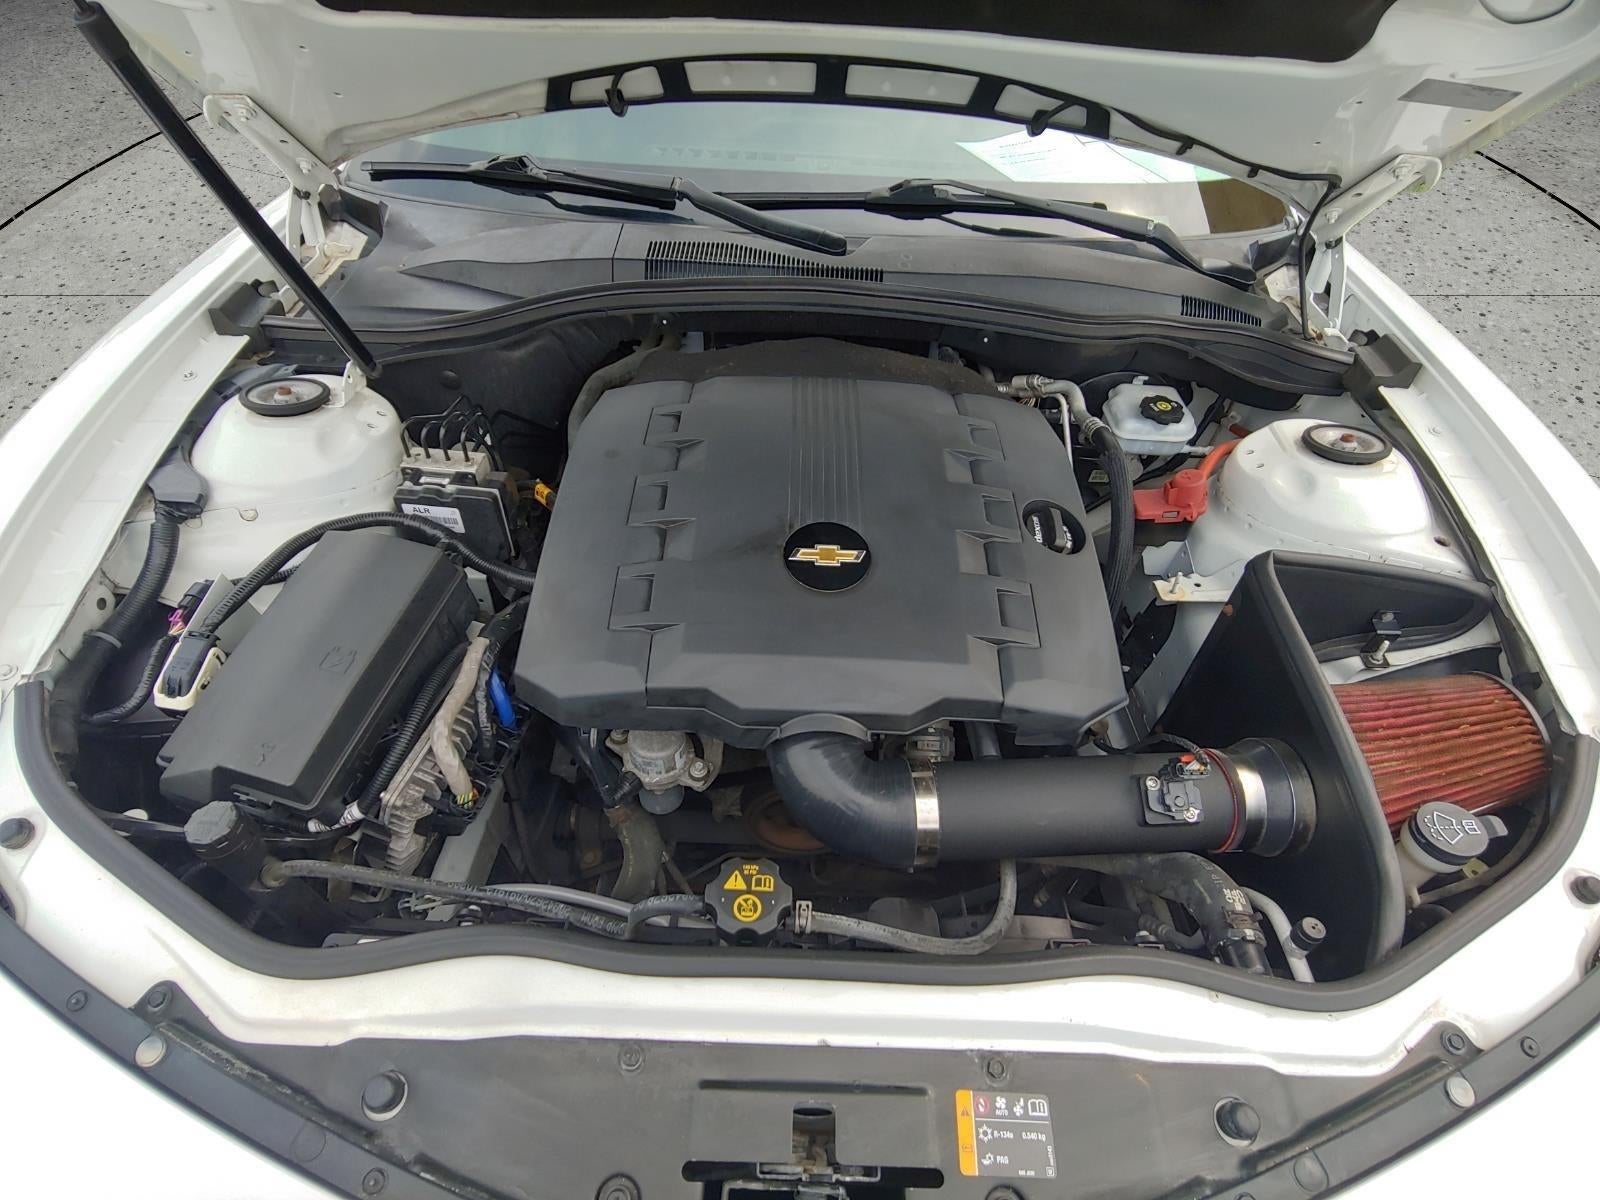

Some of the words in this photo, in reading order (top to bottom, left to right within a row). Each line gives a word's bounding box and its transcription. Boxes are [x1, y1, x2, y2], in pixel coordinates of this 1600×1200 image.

[412, 506, 430, 514] ALR
[1038, 1132, 1046, 1142] kg
[996, 1155, 1009, 1165] PAG
